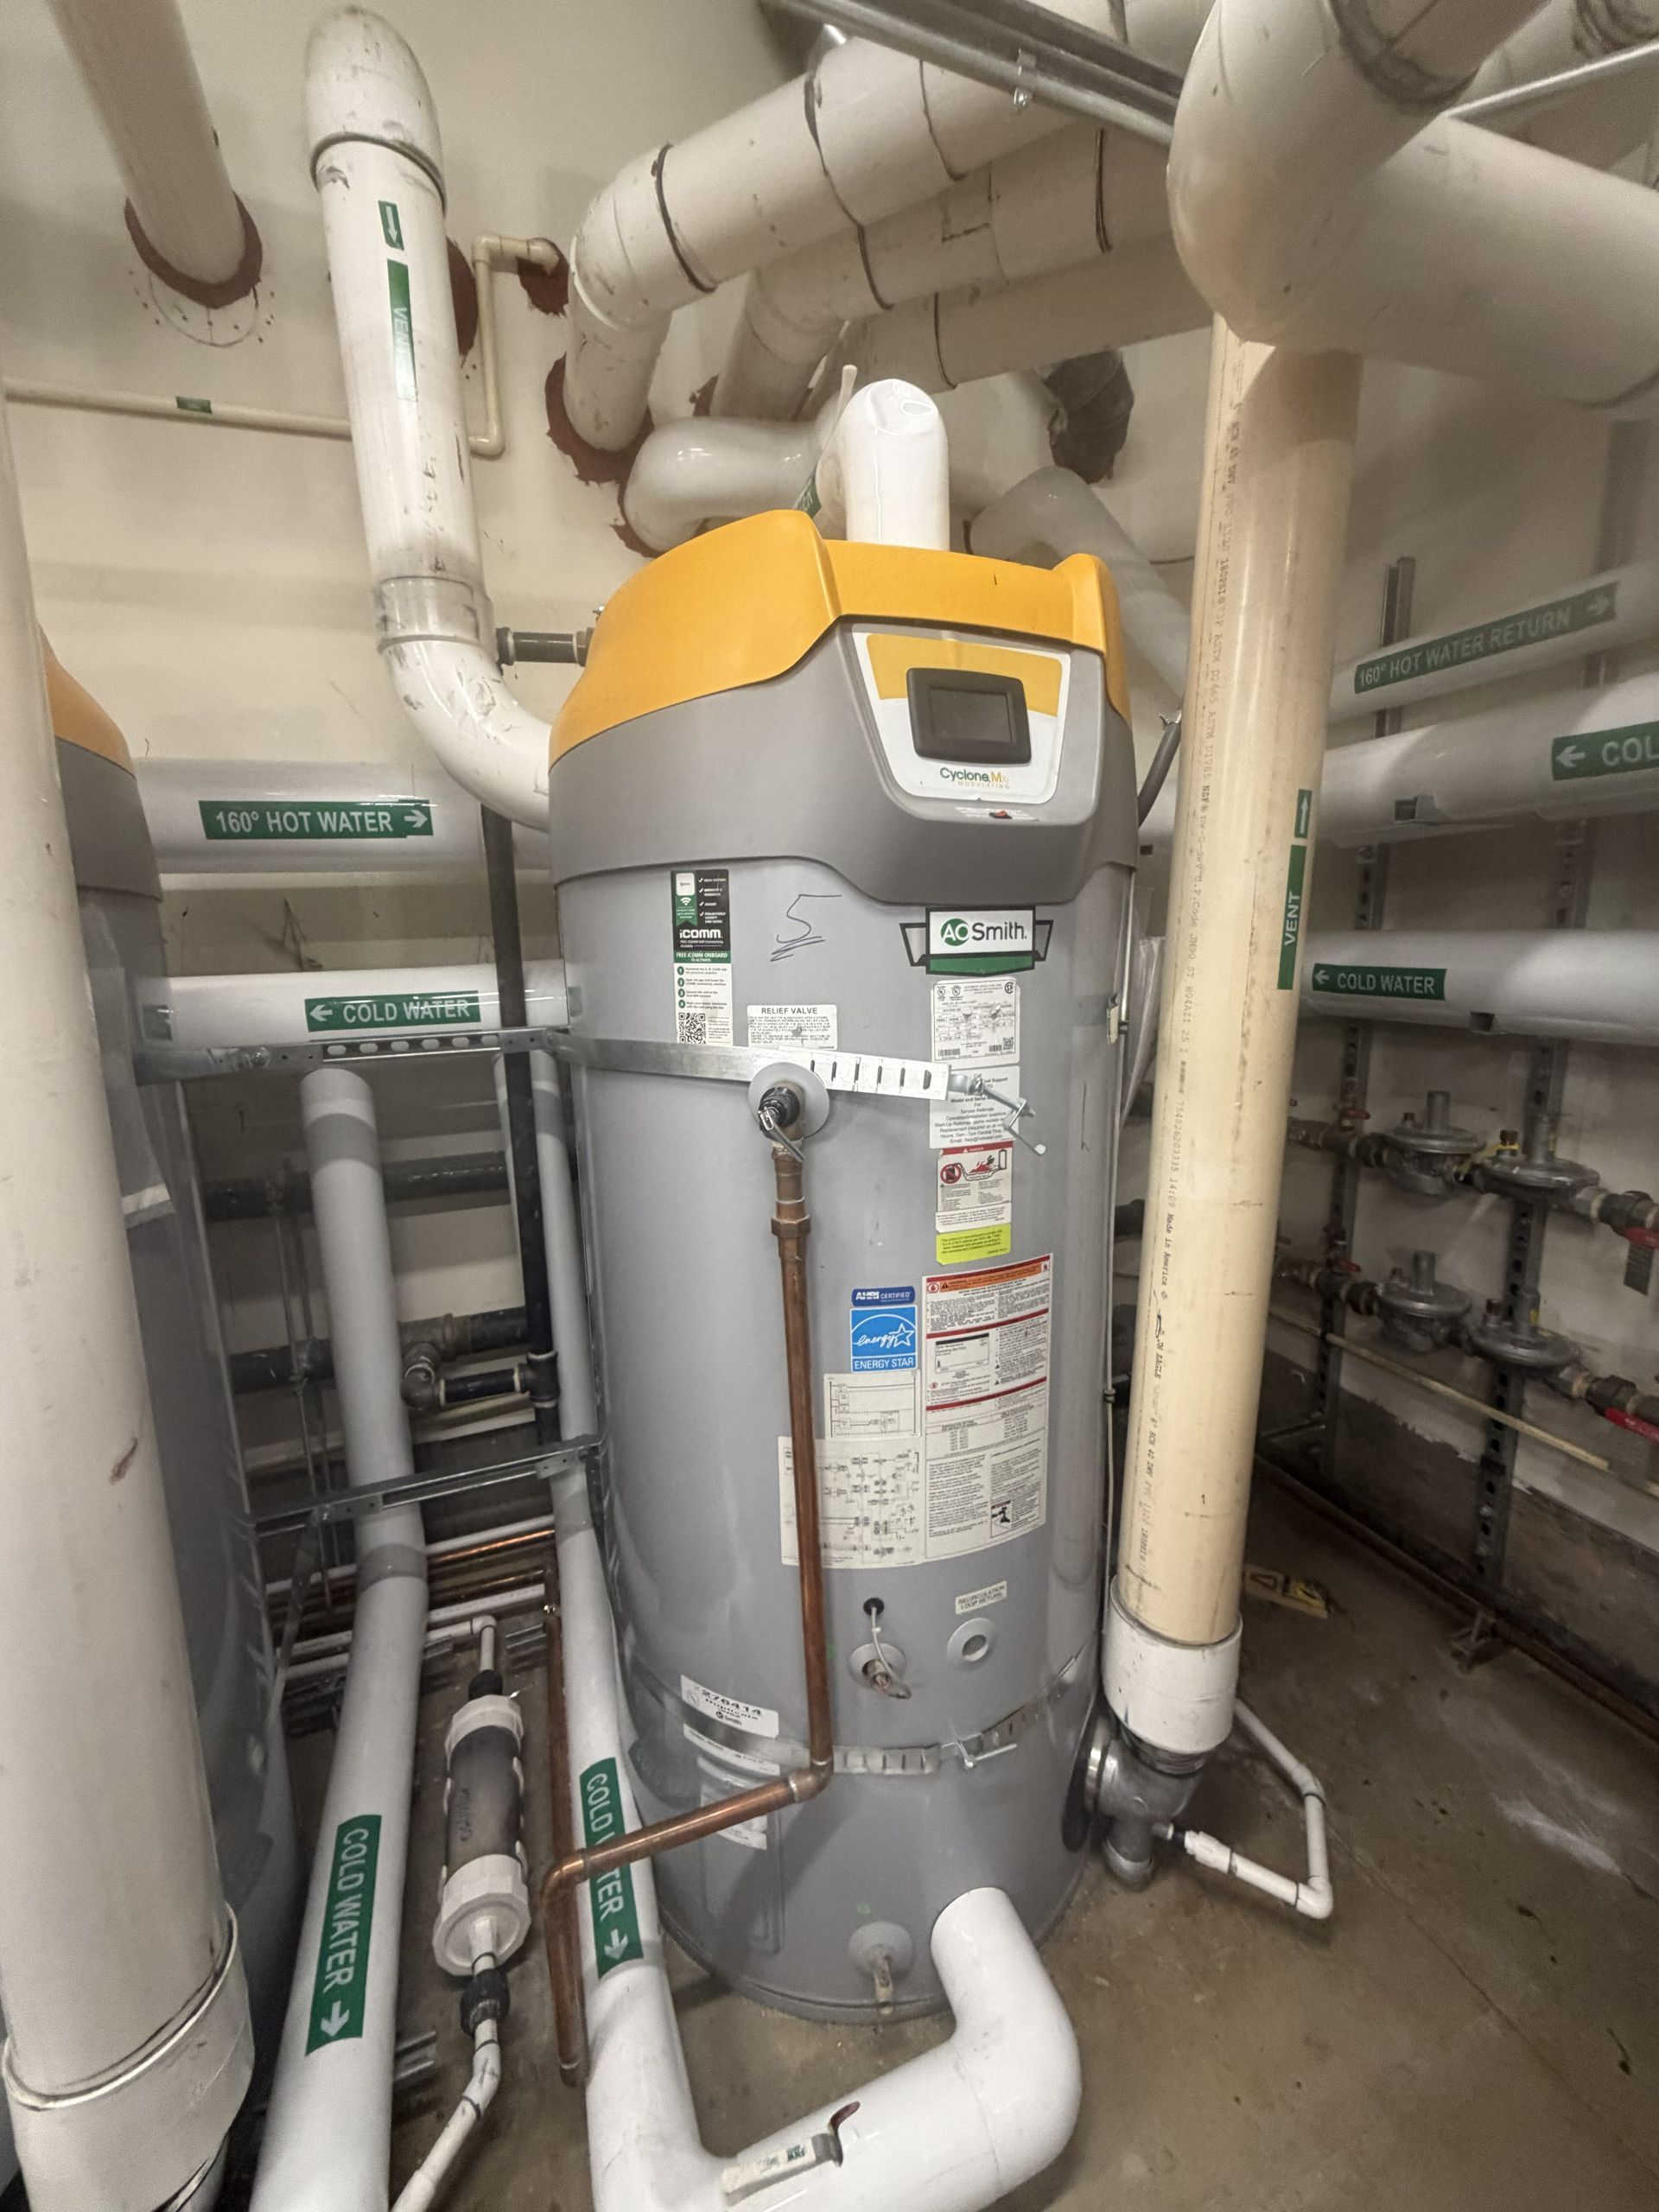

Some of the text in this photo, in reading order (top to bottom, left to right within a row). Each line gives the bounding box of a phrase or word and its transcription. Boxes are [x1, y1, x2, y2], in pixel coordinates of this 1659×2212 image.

[1389, 652, 1422, 678] HOT
[1426, 635, 1484, 667] WATER
[1491, 607, 1570, 648] RETURN
[266, 811, 311, 833] HOT
[317, 810, 394, 832] WATER
[1284, 891, 1301, 946] VENT
[1337, 972, 1435, 995] COLD WATER
[342, 999, 470, 1024] COLD WATER
[1166, 1213, 1175, 1234] Made
[1164, 1237, 1173, 1248] in
[1161, 1252, 1172, 1285] America
[880, 1291, 911, 1300] CERTIFIED
[854, 1357, 914, 1370] ENERGY STAR
[1154, 1352, 1164, 1380] EAGLE
[586, 1772, 613, 1834] COLD
[322, 1827, 370, 1993] COLD WATER
